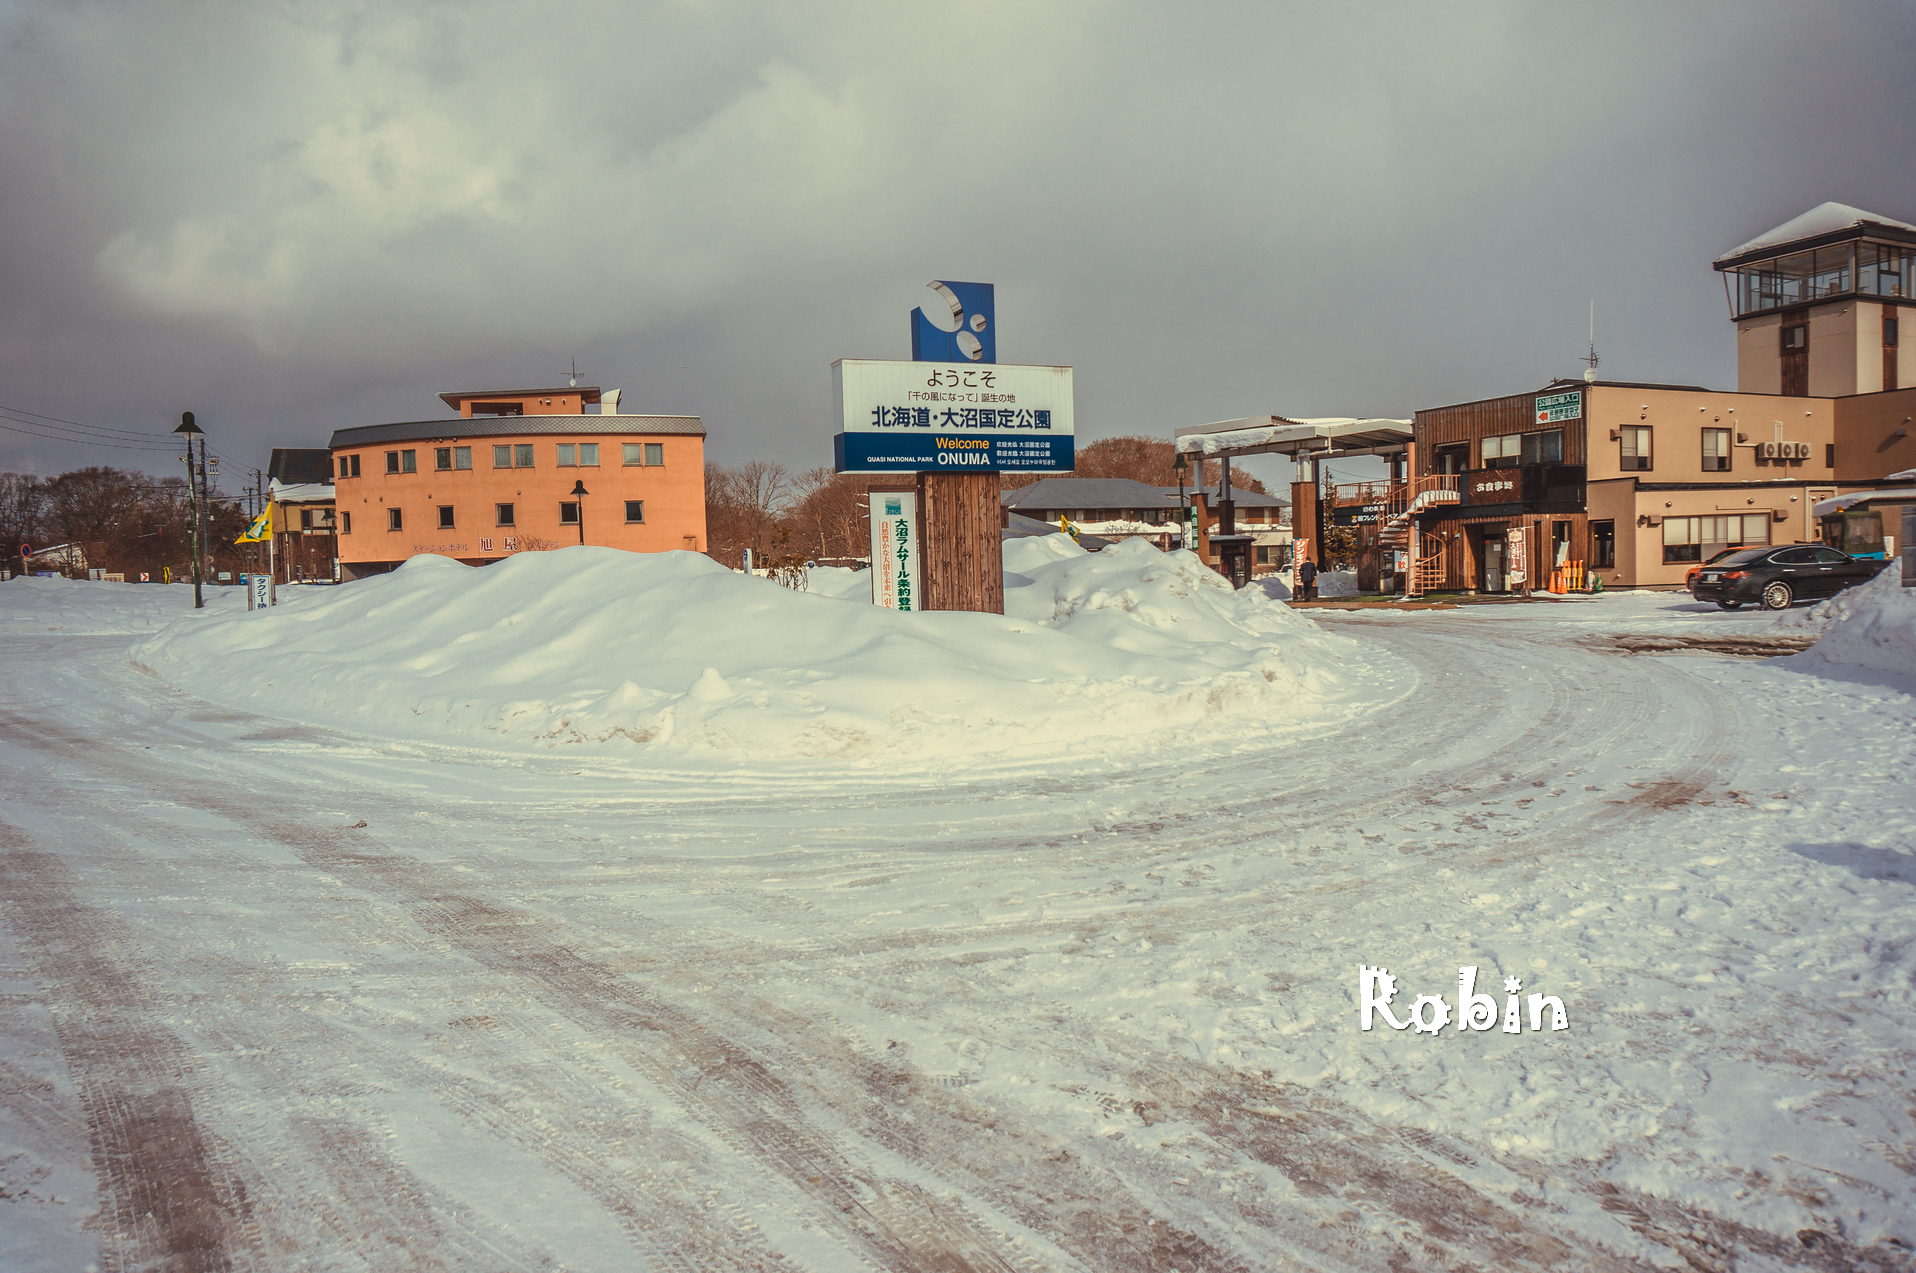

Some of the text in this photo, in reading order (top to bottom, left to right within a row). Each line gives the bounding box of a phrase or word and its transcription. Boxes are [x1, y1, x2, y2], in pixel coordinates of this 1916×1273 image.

[927, 369, 996, 388] ようこそ
[1538, 393, 1579, 406] 公園広場入口
[871, 406, 1051, 429] 北海道・大沼国定公園
[936, 437, 990, 449] Welcome
[937, 452, 991, 465] ONUMA
[1476, 481, 1513, 492] お食事処
[412, 543, 470, 552] ステーションホテル
